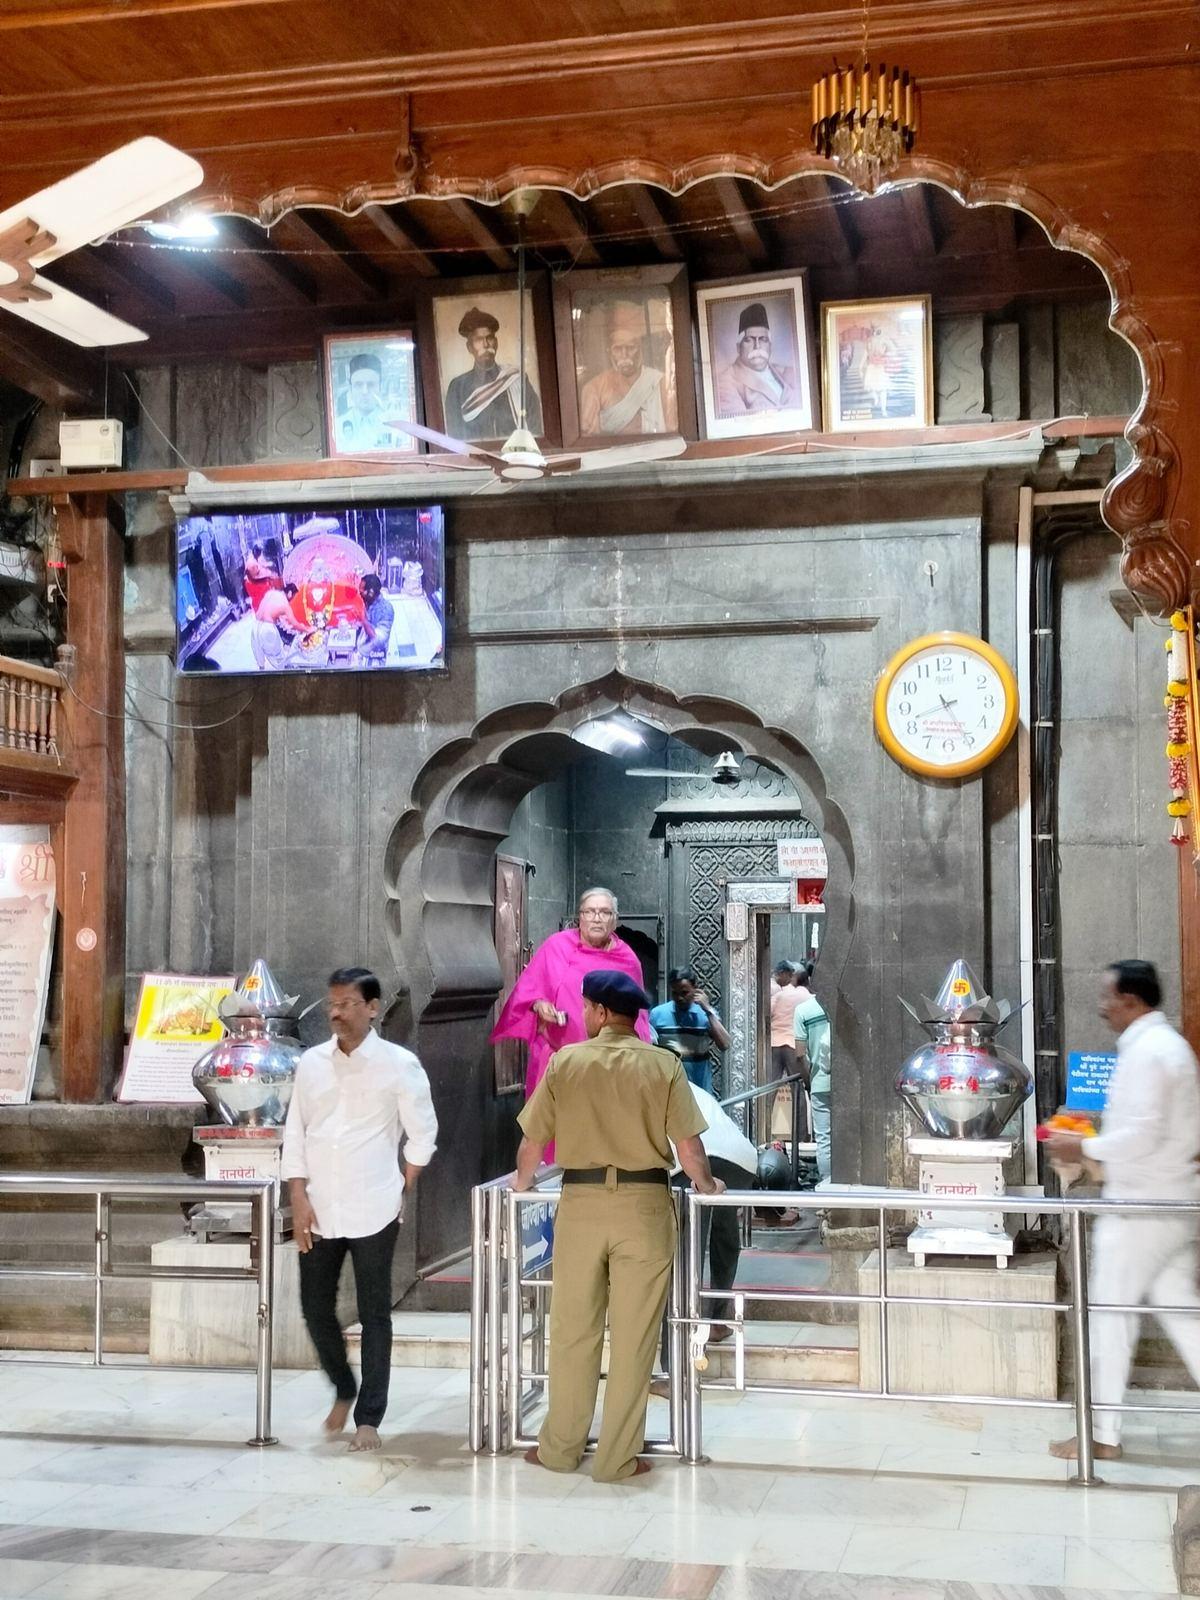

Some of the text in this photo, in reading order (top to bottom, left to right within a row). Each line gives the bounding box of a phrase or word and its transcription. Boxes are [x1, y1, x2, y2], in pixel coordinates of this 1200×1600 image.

[918, 664, 930, 679] 11
[936, 657, 952, 672] 12
[962, 661, 967, 675] 1
[903, 681, 918, 695] 10
[976, 675, 987, 690] 2
[899, 702, 912, 716] 9
[984, 695, 995, 709] 3
[907, 720, 918, 735] 8
[977, 715, 987, 729] 4
[922, 735, 933, 749] 7
[942, 739, 955, 753] 6
[963, 732, 975, 747] 5
[219, 1166, 255, 1179] दानपेटी
